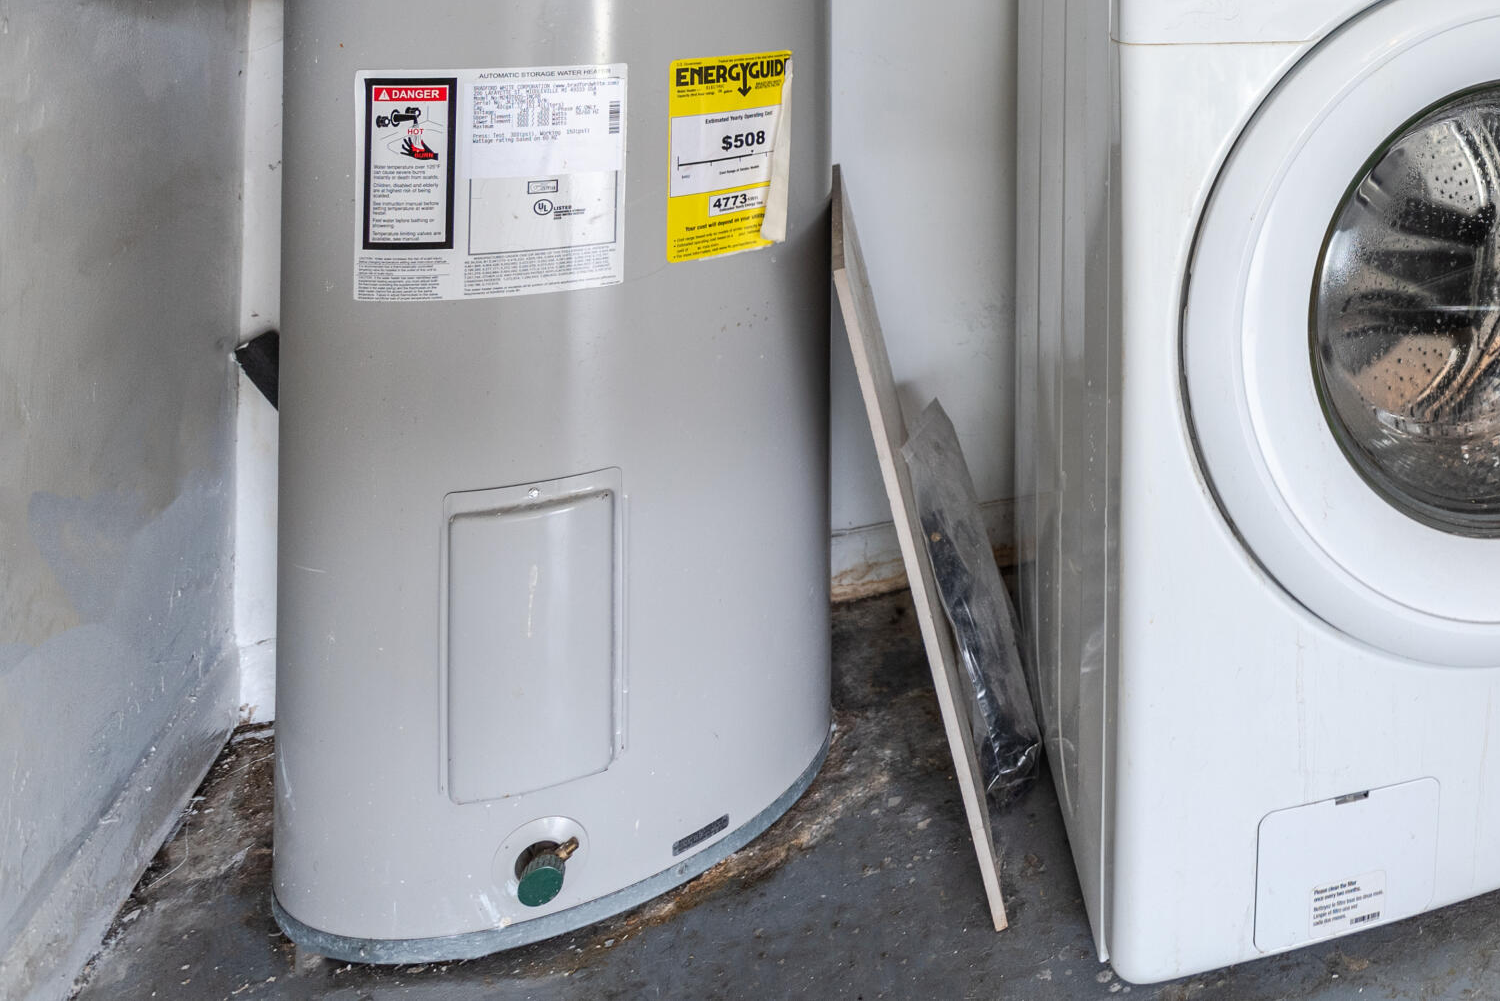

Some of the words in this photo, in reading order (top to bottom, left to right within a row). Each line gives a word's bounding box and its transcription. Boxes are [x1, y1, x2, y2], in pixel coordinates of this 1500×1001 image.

[392, 89, 440, 99] DANGER
[705, 116, 729, 124] Estimated
[408, 128, 424, 136] HOT
[721, 130, 766, 152] $508
[713, 193, 748, 209] 4773
[538, 203, 548, 212] UL
